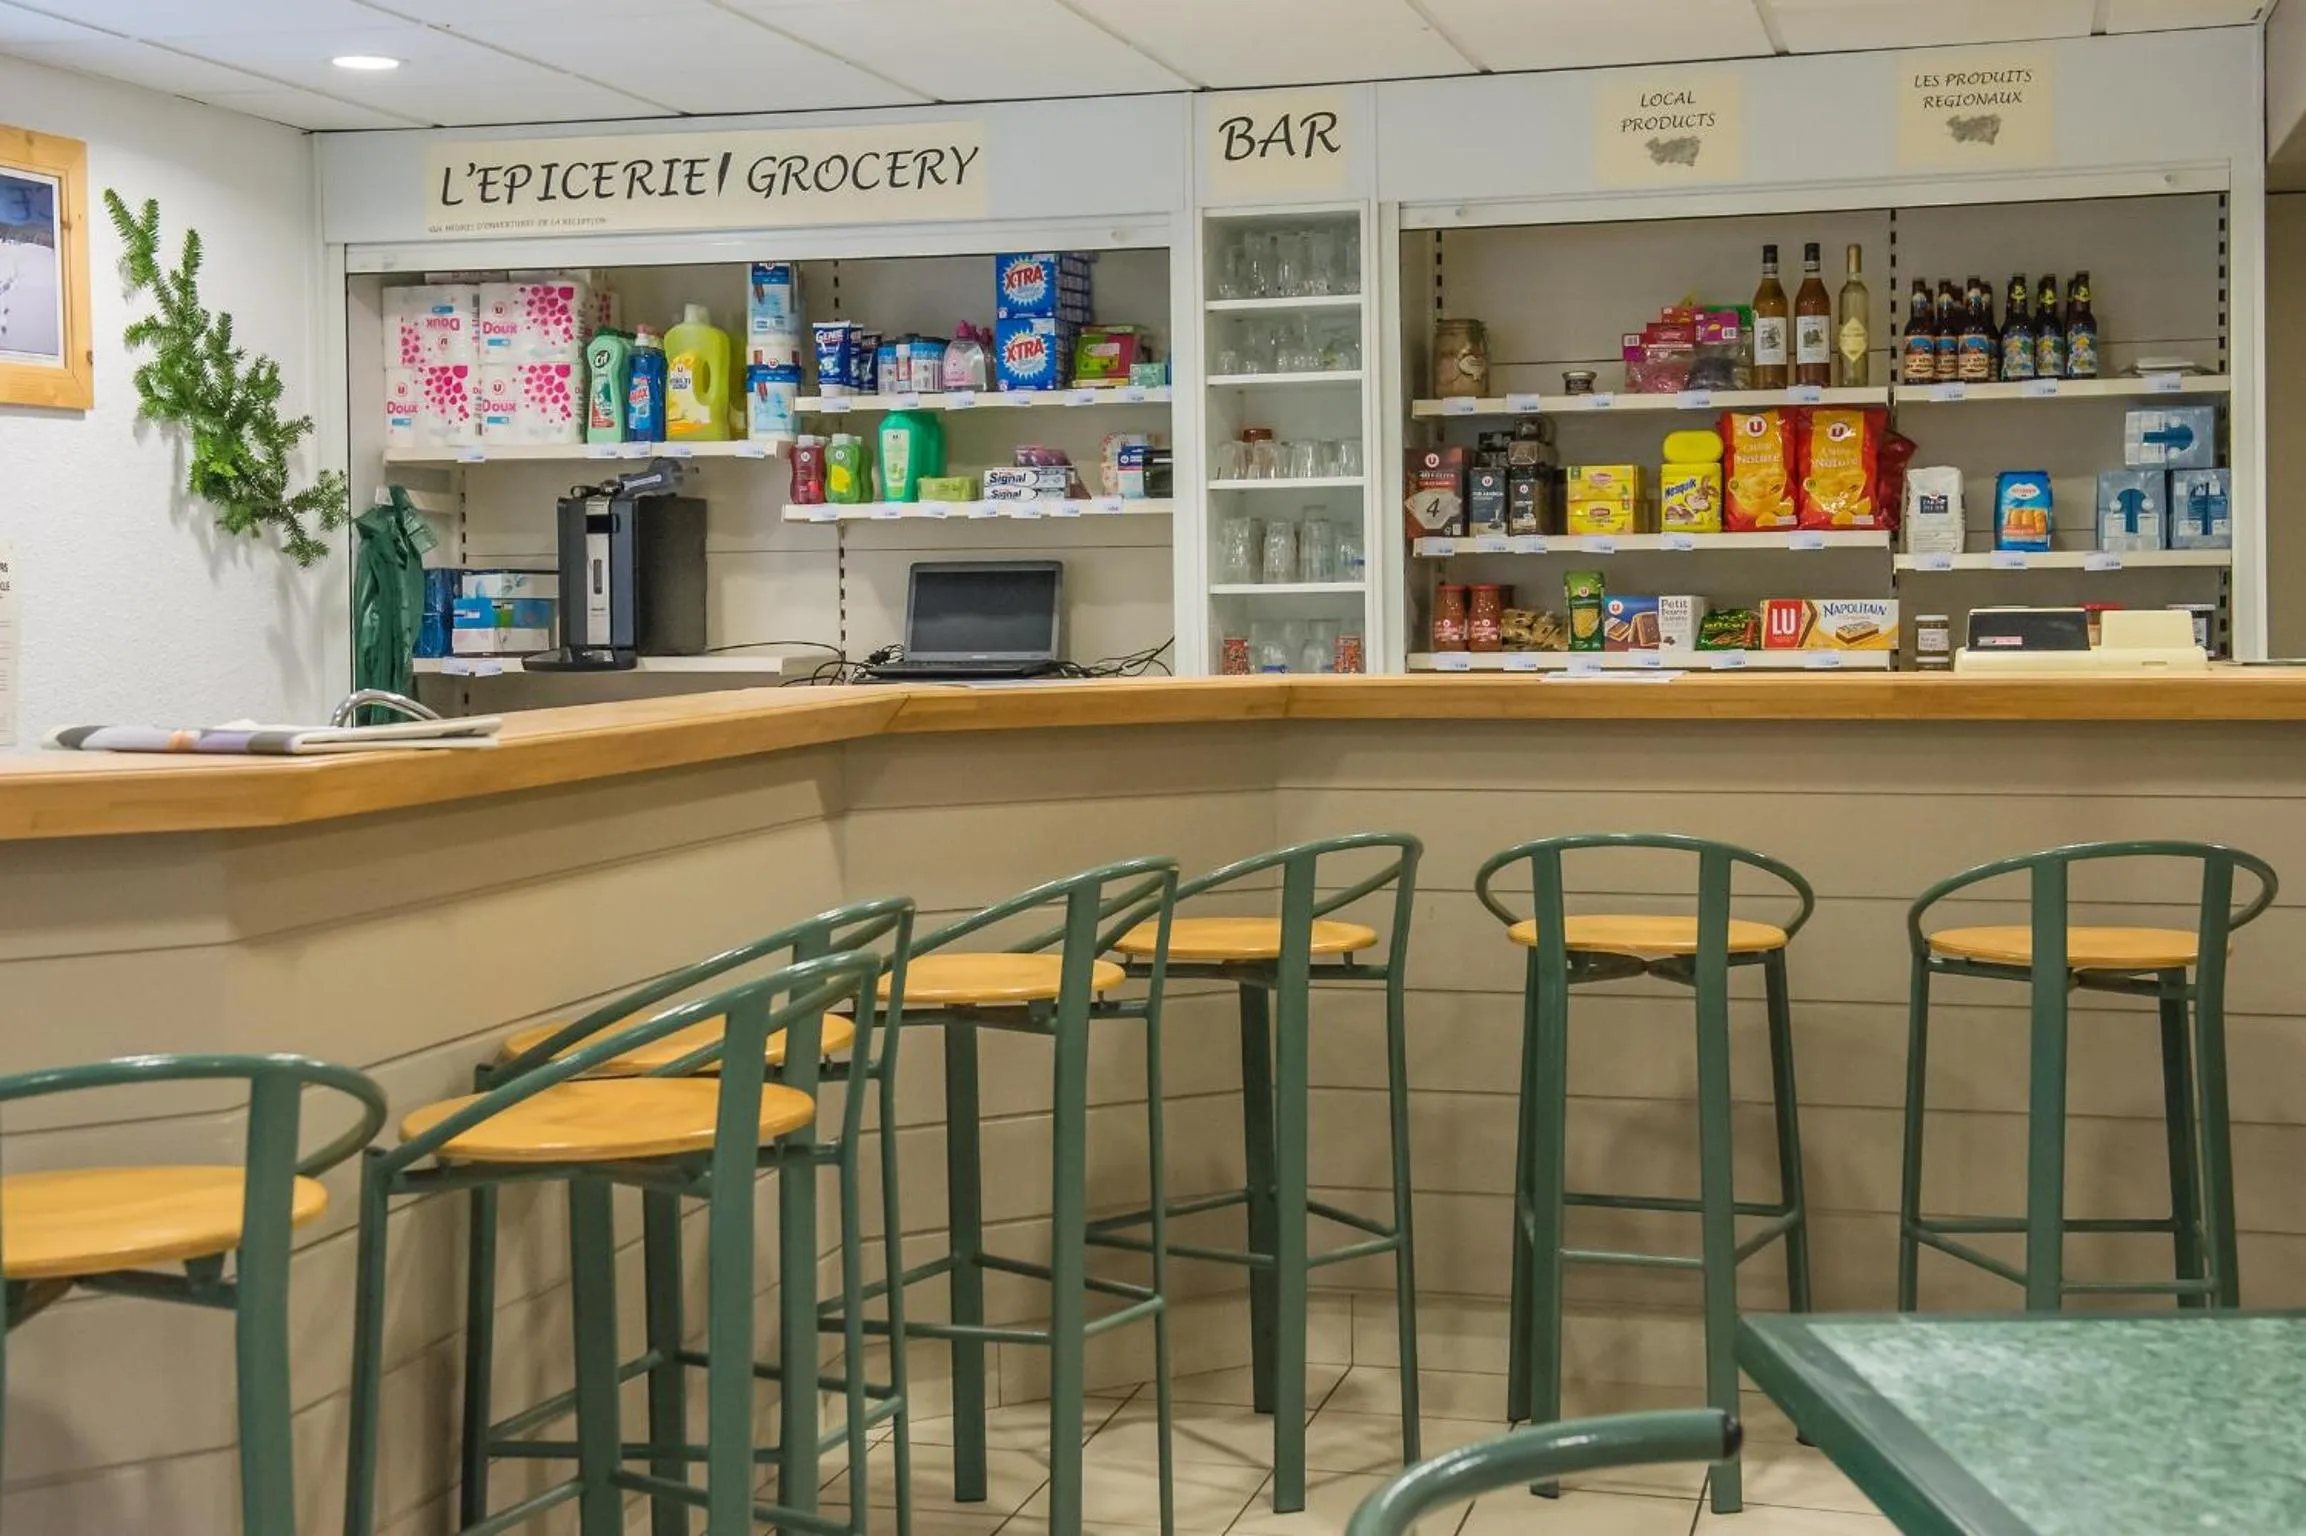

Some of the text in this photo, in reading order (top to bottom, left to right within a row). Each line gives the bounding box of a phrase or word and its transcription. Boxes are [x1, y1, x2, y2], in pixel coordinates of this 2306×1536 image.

[1914, 69, 2032, 88] LES PRODUITS
[1640, 90, 1696, 108] LOCAL
[1923, 91, 2024, 109] REGIONAUX
[1620, 112, 1716, 132] PRODUCTS
[1218, 111, 1341, 161] BAR
[747, 145, 980, 199] GROCERY
[989, 471, 1027, 485] Signal
[990, 487, 1022, 500] Signal
[1426, 496, 1440, 518] 4
[1661, 599, 1688, 609] Petit
[1822, 601, 1888, 618] NAPOLITAIN
[1772, 608, 1796, 635] LU
